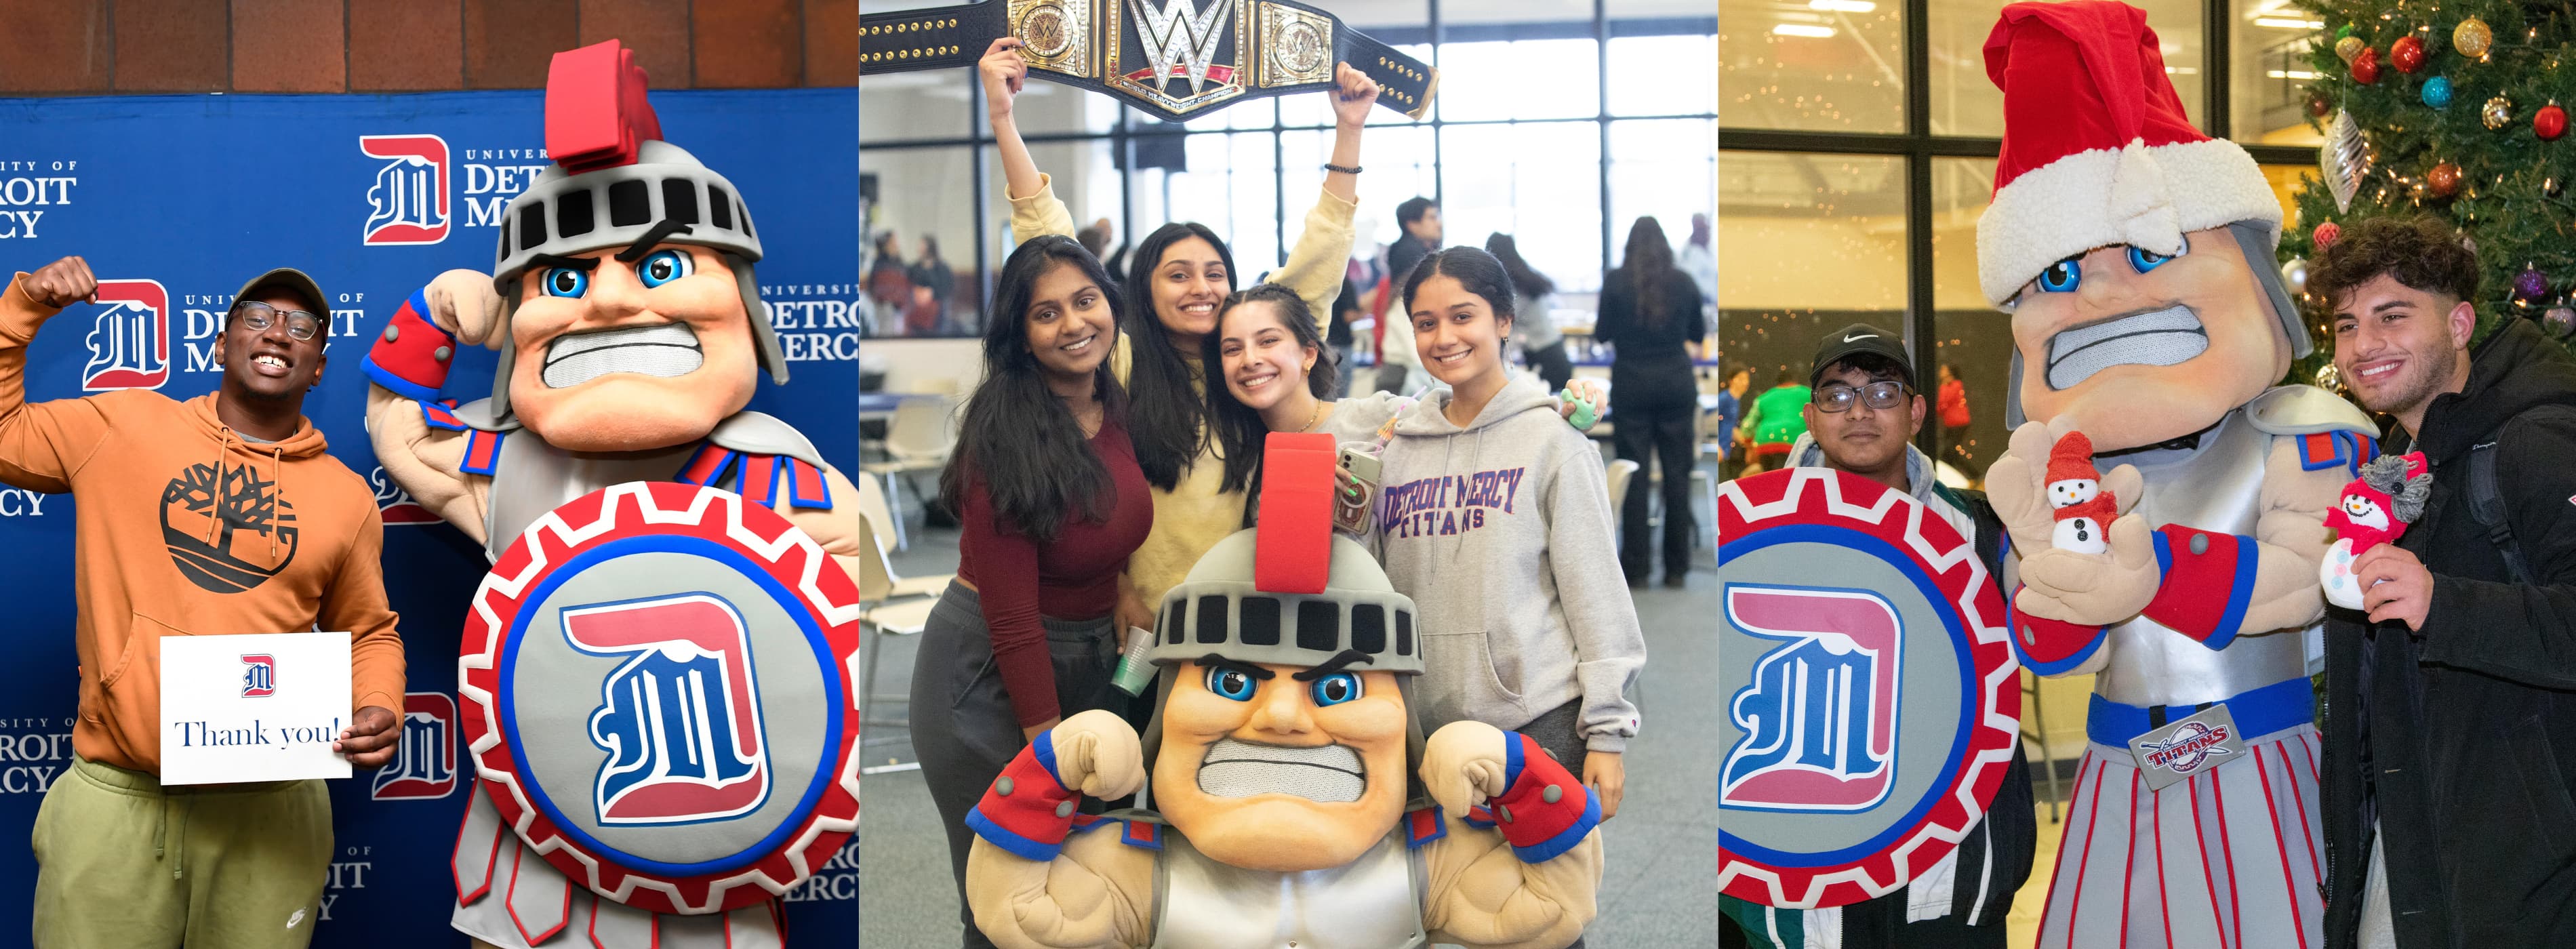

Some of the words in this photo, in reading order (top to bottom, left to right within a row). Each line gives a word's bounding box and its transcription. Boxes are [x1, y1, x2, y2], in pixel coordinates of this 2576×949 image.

[1197, 88, 1232, 102] CHAMPION
[52, 161, 77, 171] OF
[463, 163, 550, 194] DET
[340, 293, 364, 303] OF
[1384, 475, 1453, 538] DETROIT
[1455, 467, 1525, 514] MERCY
[1401, 508, 1485, 538] TITANS
[174, 720, 271, 747] Thank
[281, 717, 338, 750] you!
[2147, 727, 2228, 767] TITANS
[2163, 740, 2187, 752] DETROIT
[2188, 732, 2209, 743] MERCY
[0, 766, 56, 793] CY
[348, 847, 371, 855] OF
[324, 862, 371, 889] IT
